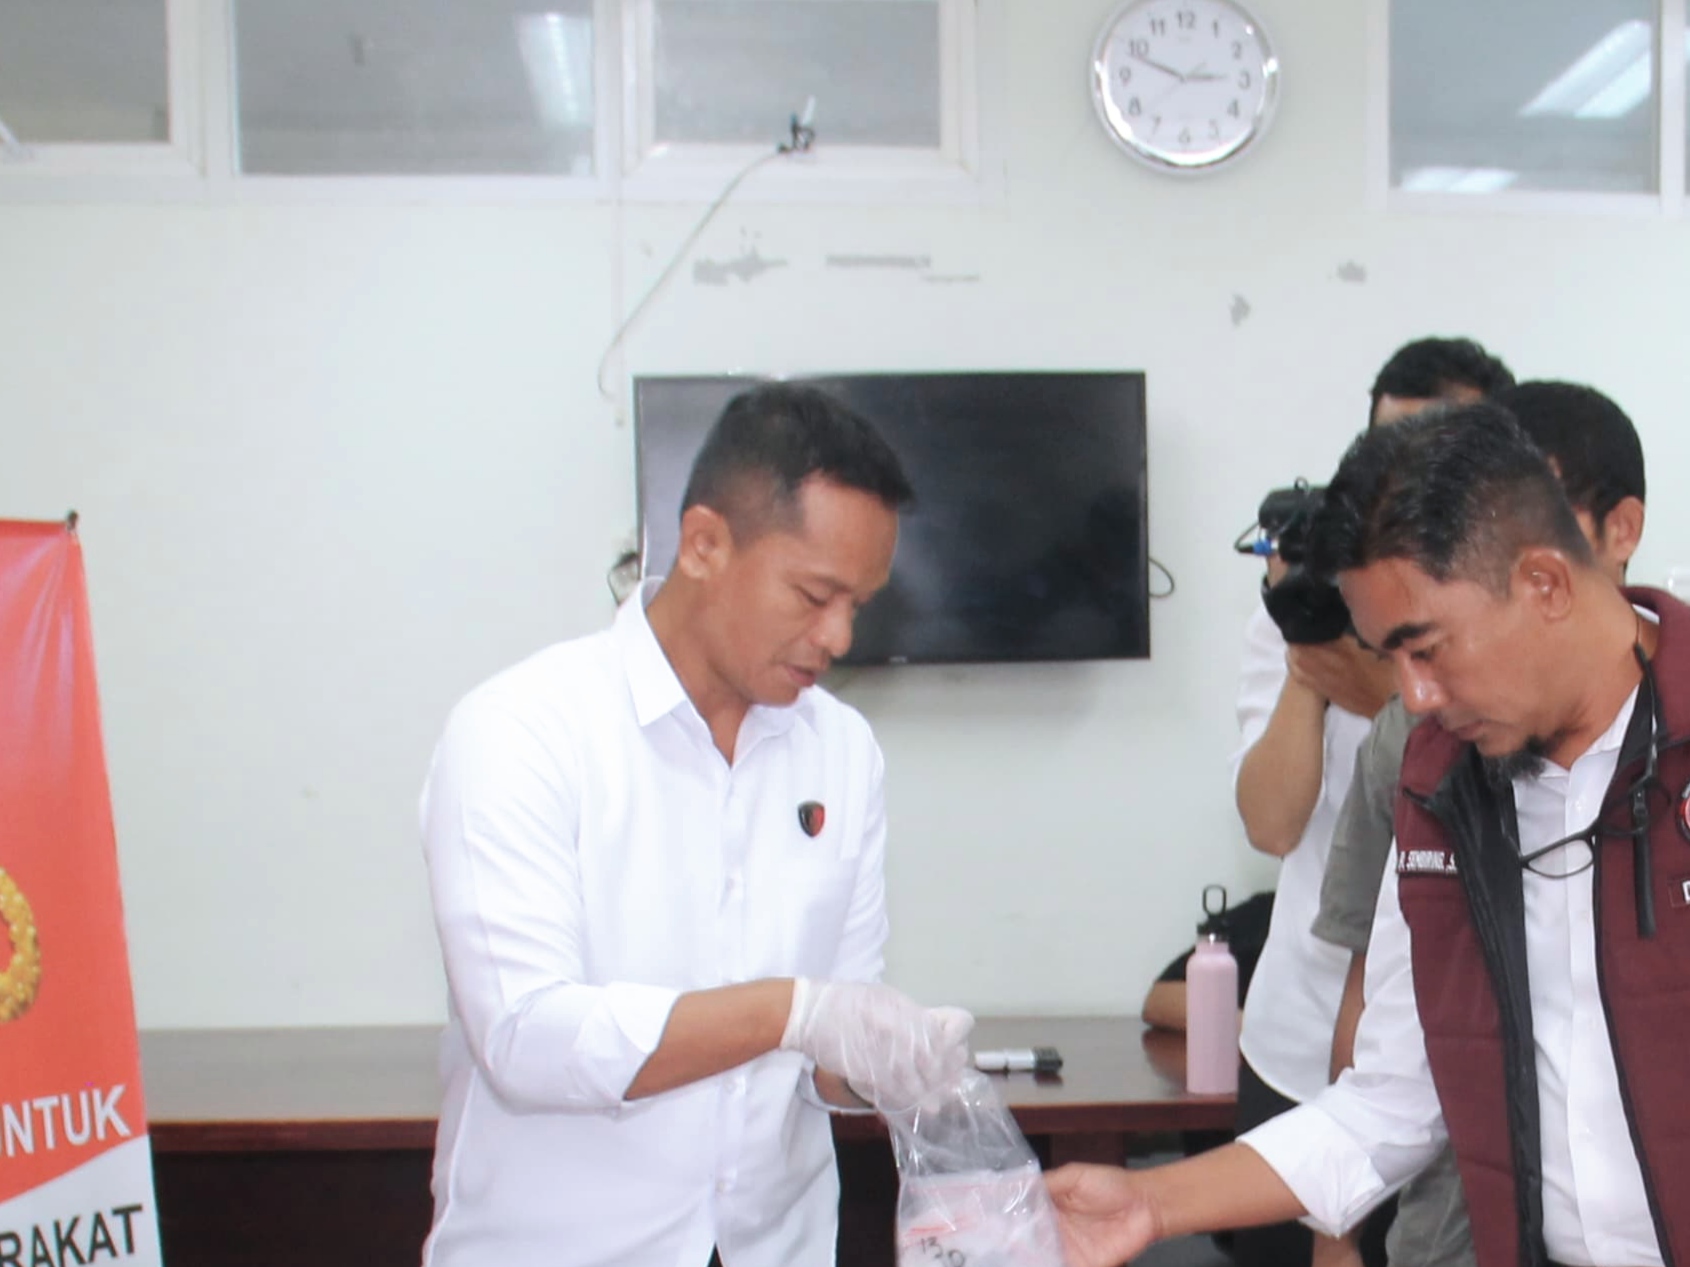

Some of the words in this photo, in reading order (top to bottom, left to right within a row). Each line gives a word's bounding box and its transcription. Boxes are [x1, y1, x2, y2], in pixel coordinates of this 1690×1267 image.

[1150, 18, 1166, 36] 11
[1176, 11, 1196, 29] 12
[1231, 41, 1242, 59] 2
[1238, 70, 1251, 90] 3
[1227, 99, 1239, 119] 4
[1152, 115, 1162, 134] 7
[0, 1083, 131, 1158] NTUK
